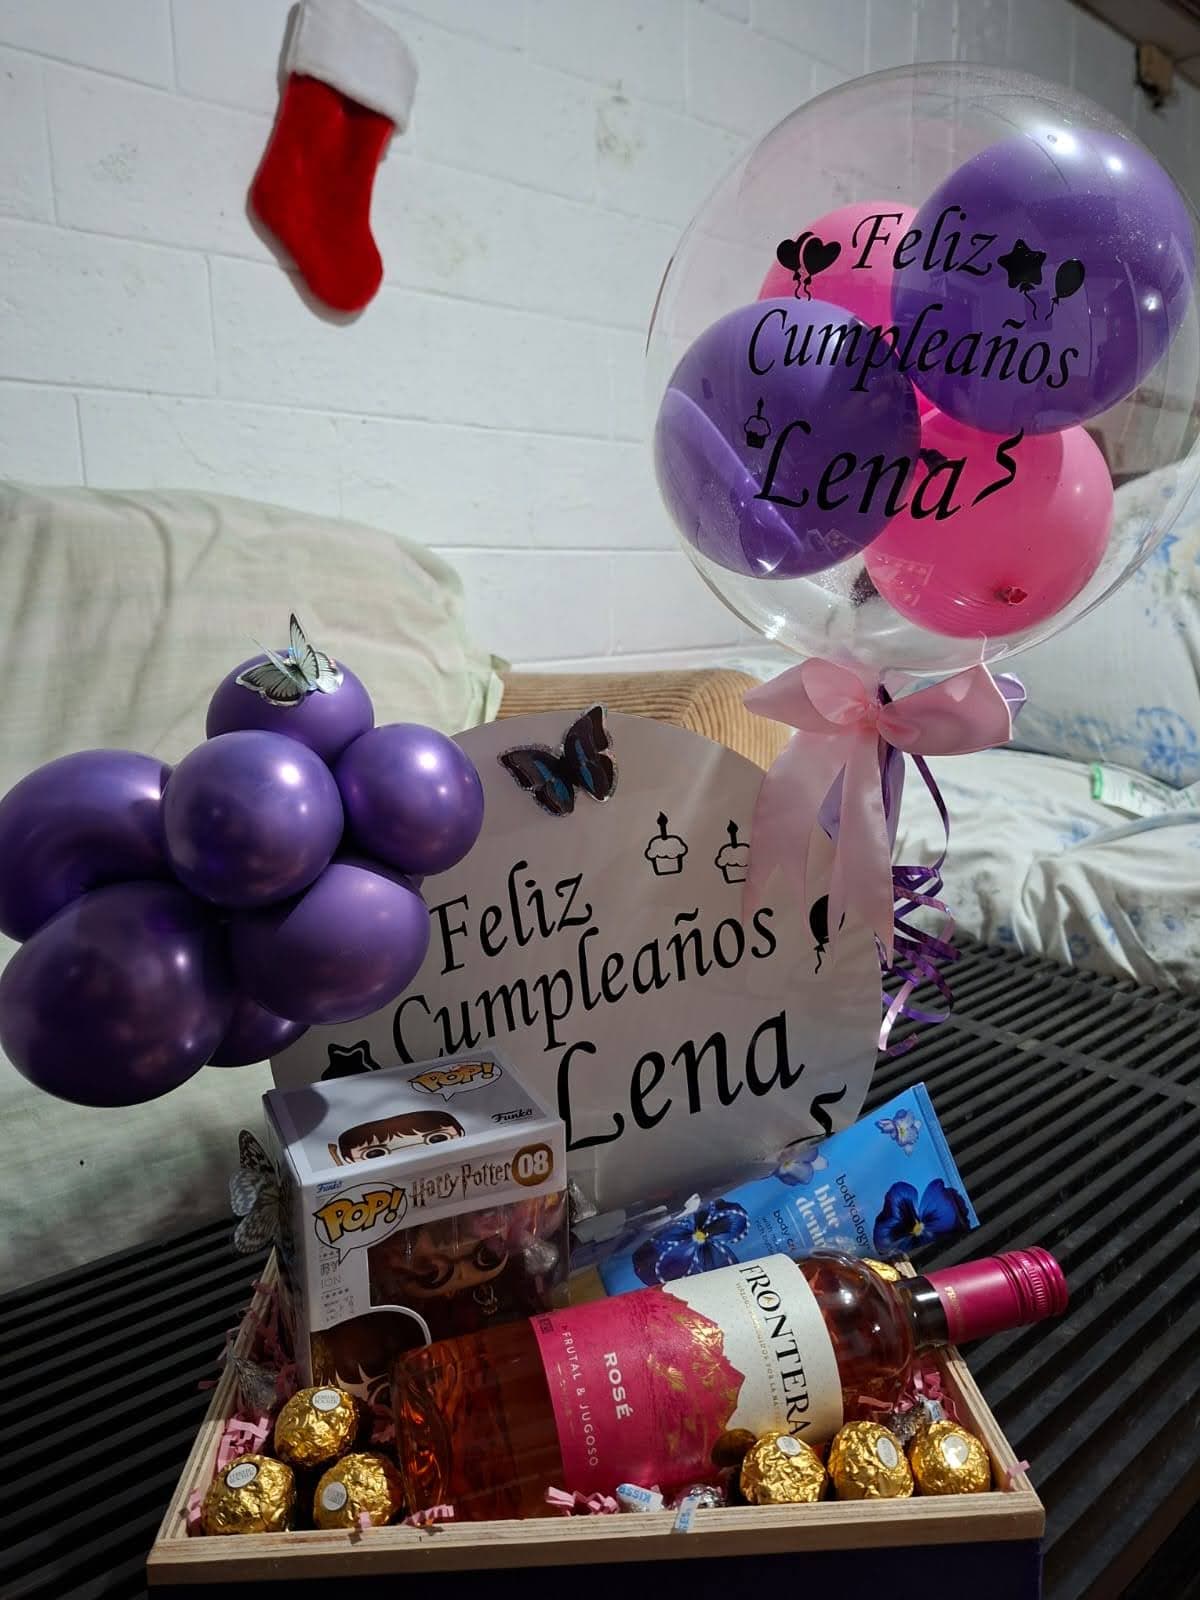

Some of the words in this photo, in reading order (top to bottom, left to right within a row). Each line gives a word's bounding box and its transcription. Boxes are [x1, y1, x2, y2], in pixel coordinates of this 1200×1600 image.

[851, 206, 1000, 277] Feliz
[747, 303, 1079, 393] Cumpleaños
[753, 419, 968, 521] Lena
[429, 859, 593, 976] Feliz
[392, 906, 778, 1066] Cumpleaños
[408, 1061, 495, 1092] POP!
[555, 1010, 806, 1152] Lena
[491, 1108, 533, 1124] Funko
[316, 1180, 343, 1194] Funko
[408, 1172, 459, 1209] Harry
[461, 1162, 512, 1199] Potter
[517, 1150, 550, 1178] 08
[312, 1188, 406, 1244] POP!
[773, 1210, 790, 1236] body
[814, 1184, 839, 1228] blue
[835, 1173, 871, 1249] bodycology
[562, 1332, 583, 1380] FRUTAL
[739, 1265, 811, 1435] FRONTERA
[576, 1387, 586, 1397] &
[603, 1352, 634, 1419] ROSÉ
[579, 1403, 599, 1466] JUGOSO
